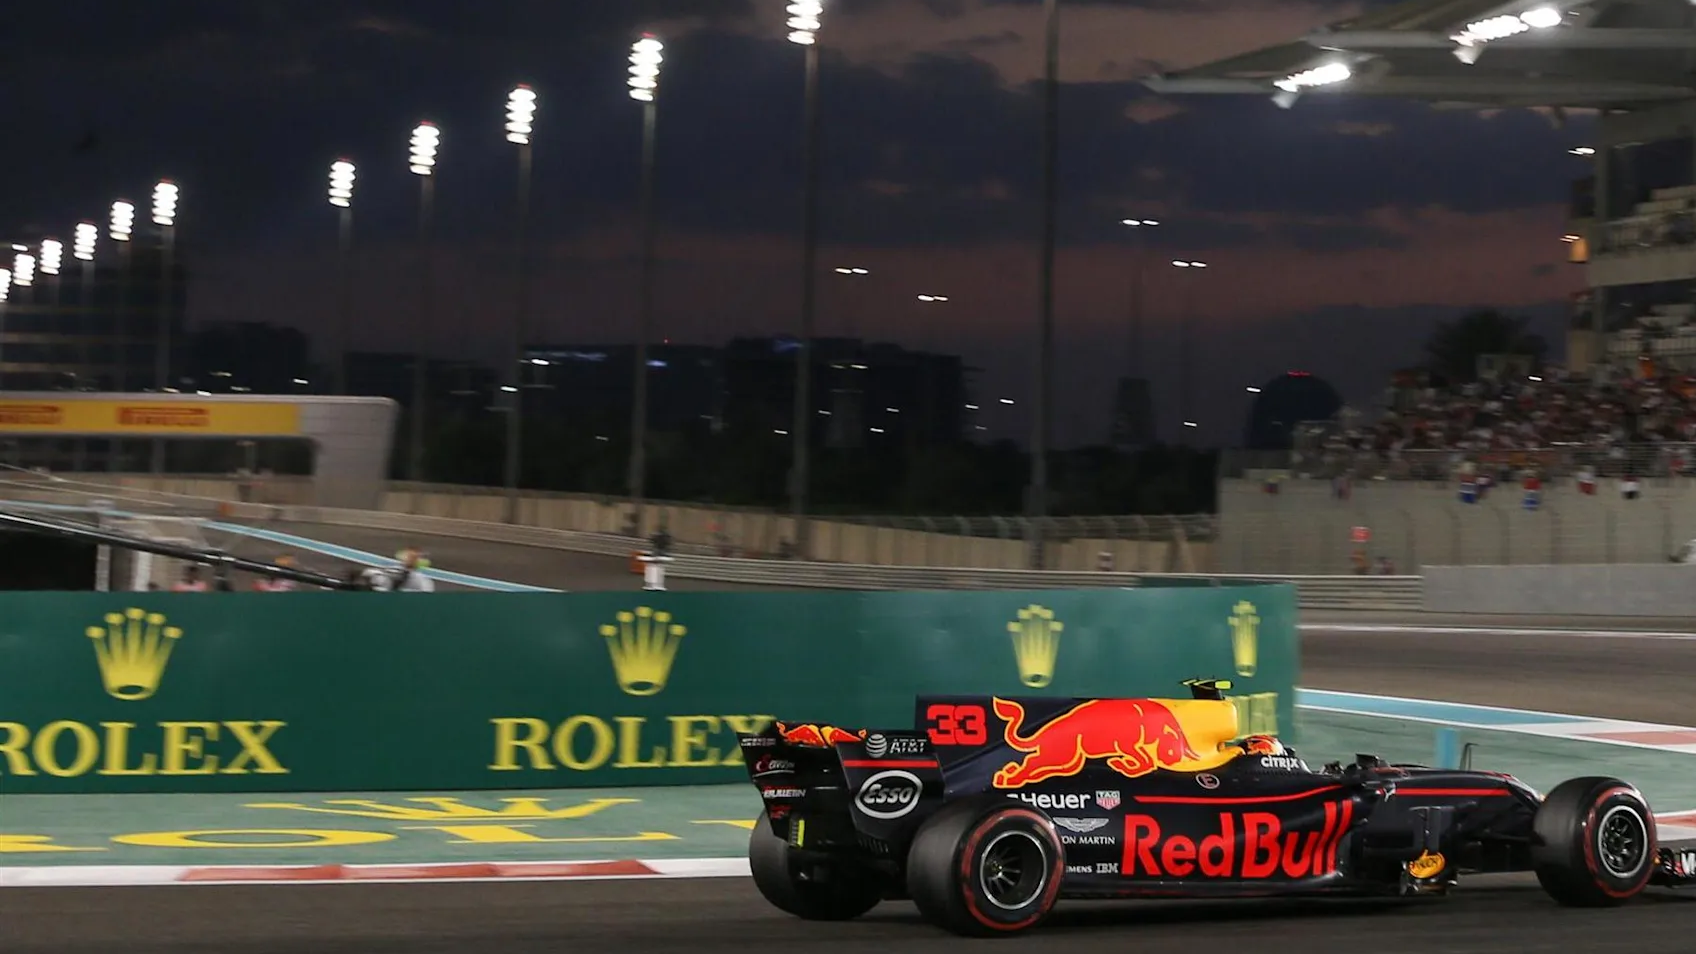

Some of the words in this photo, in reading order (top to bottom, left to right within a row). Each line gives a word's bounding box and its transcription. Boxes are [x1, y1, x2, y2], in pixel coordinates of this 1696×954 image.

[927, 704, 987, 745] 33
[0, 720, 291, 777] ROLEX
[890, 738, 927, 754] AT&T
[1079, 836, 1116, 845] MARTIN
[1121, 812, 1235, 877] Red
[1241, 799, 1354, 878] Bull
[1096, 862, 1119, 874] IBM
